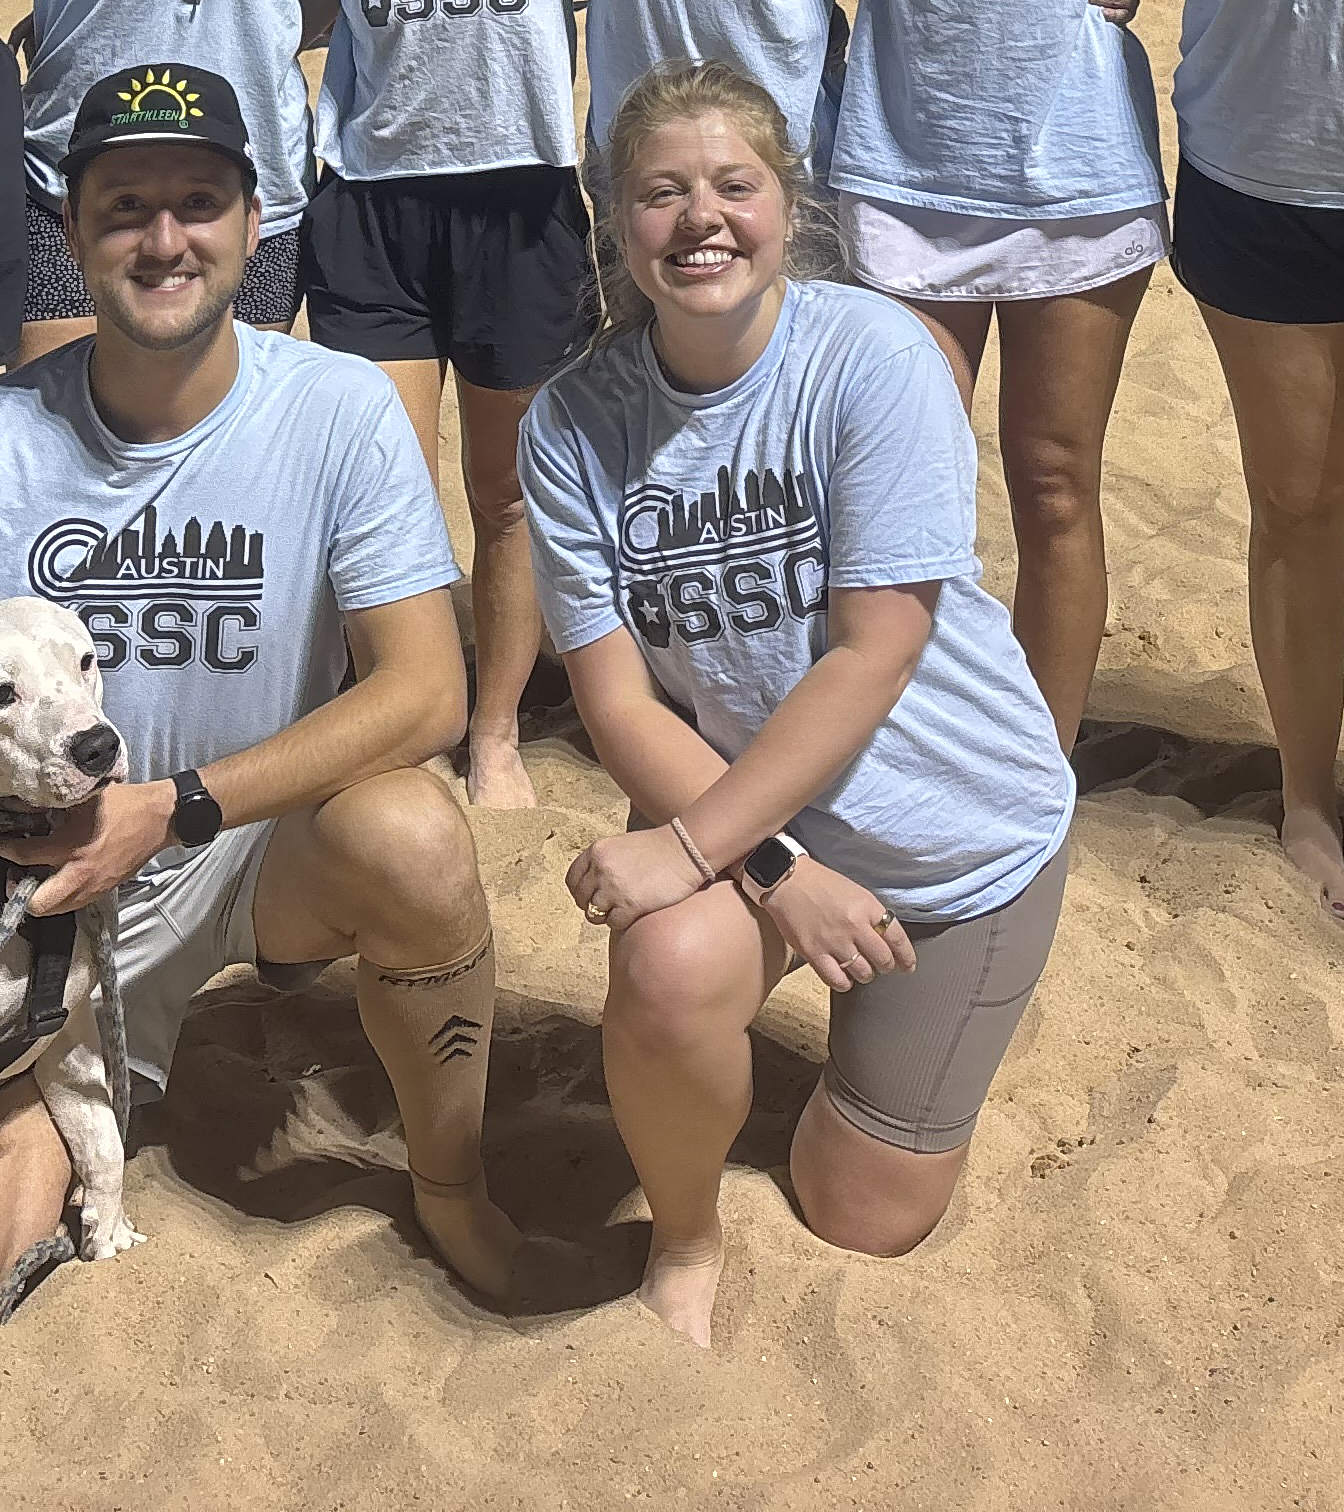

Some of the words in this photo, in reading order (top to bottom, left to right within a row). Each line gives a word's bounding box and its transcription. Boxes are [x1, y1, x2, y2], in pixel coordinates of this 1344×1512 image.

[698, 507, 788, 540] AUSTIN
[115, 556, 224, 580] AUSTIN
[667, 546, 828, 646] SSC
[80, 598, 262, 672] SSC
